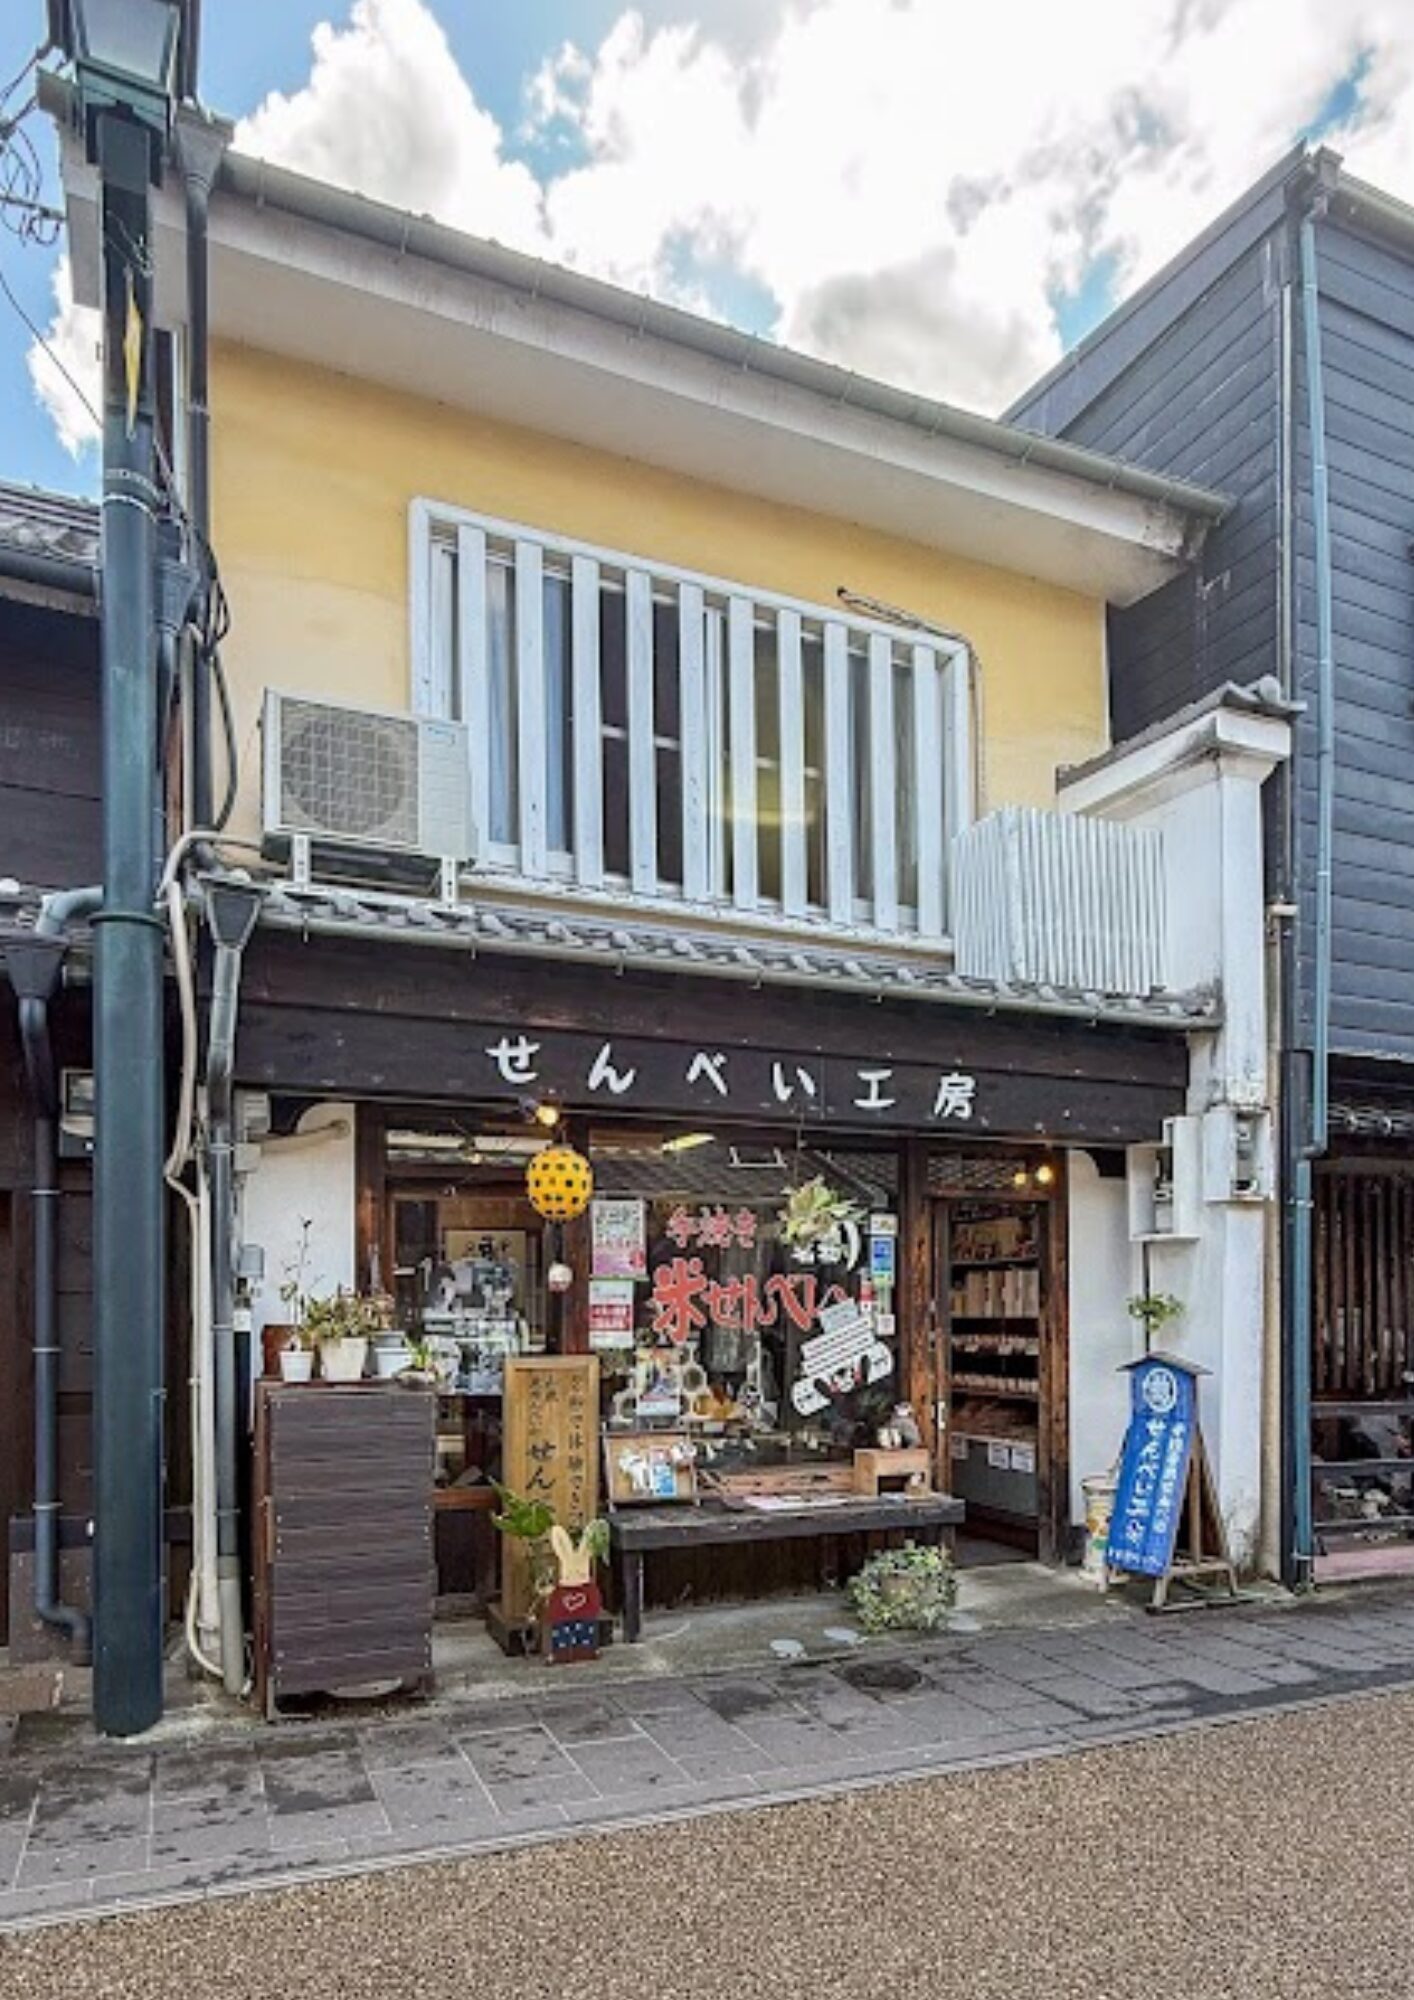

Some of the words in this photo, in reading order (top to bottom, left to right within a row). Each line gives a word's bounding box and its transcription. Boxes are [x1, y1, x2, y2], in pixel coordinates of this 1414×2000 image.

[486, 1036, 977, 1119] せんべい工房
